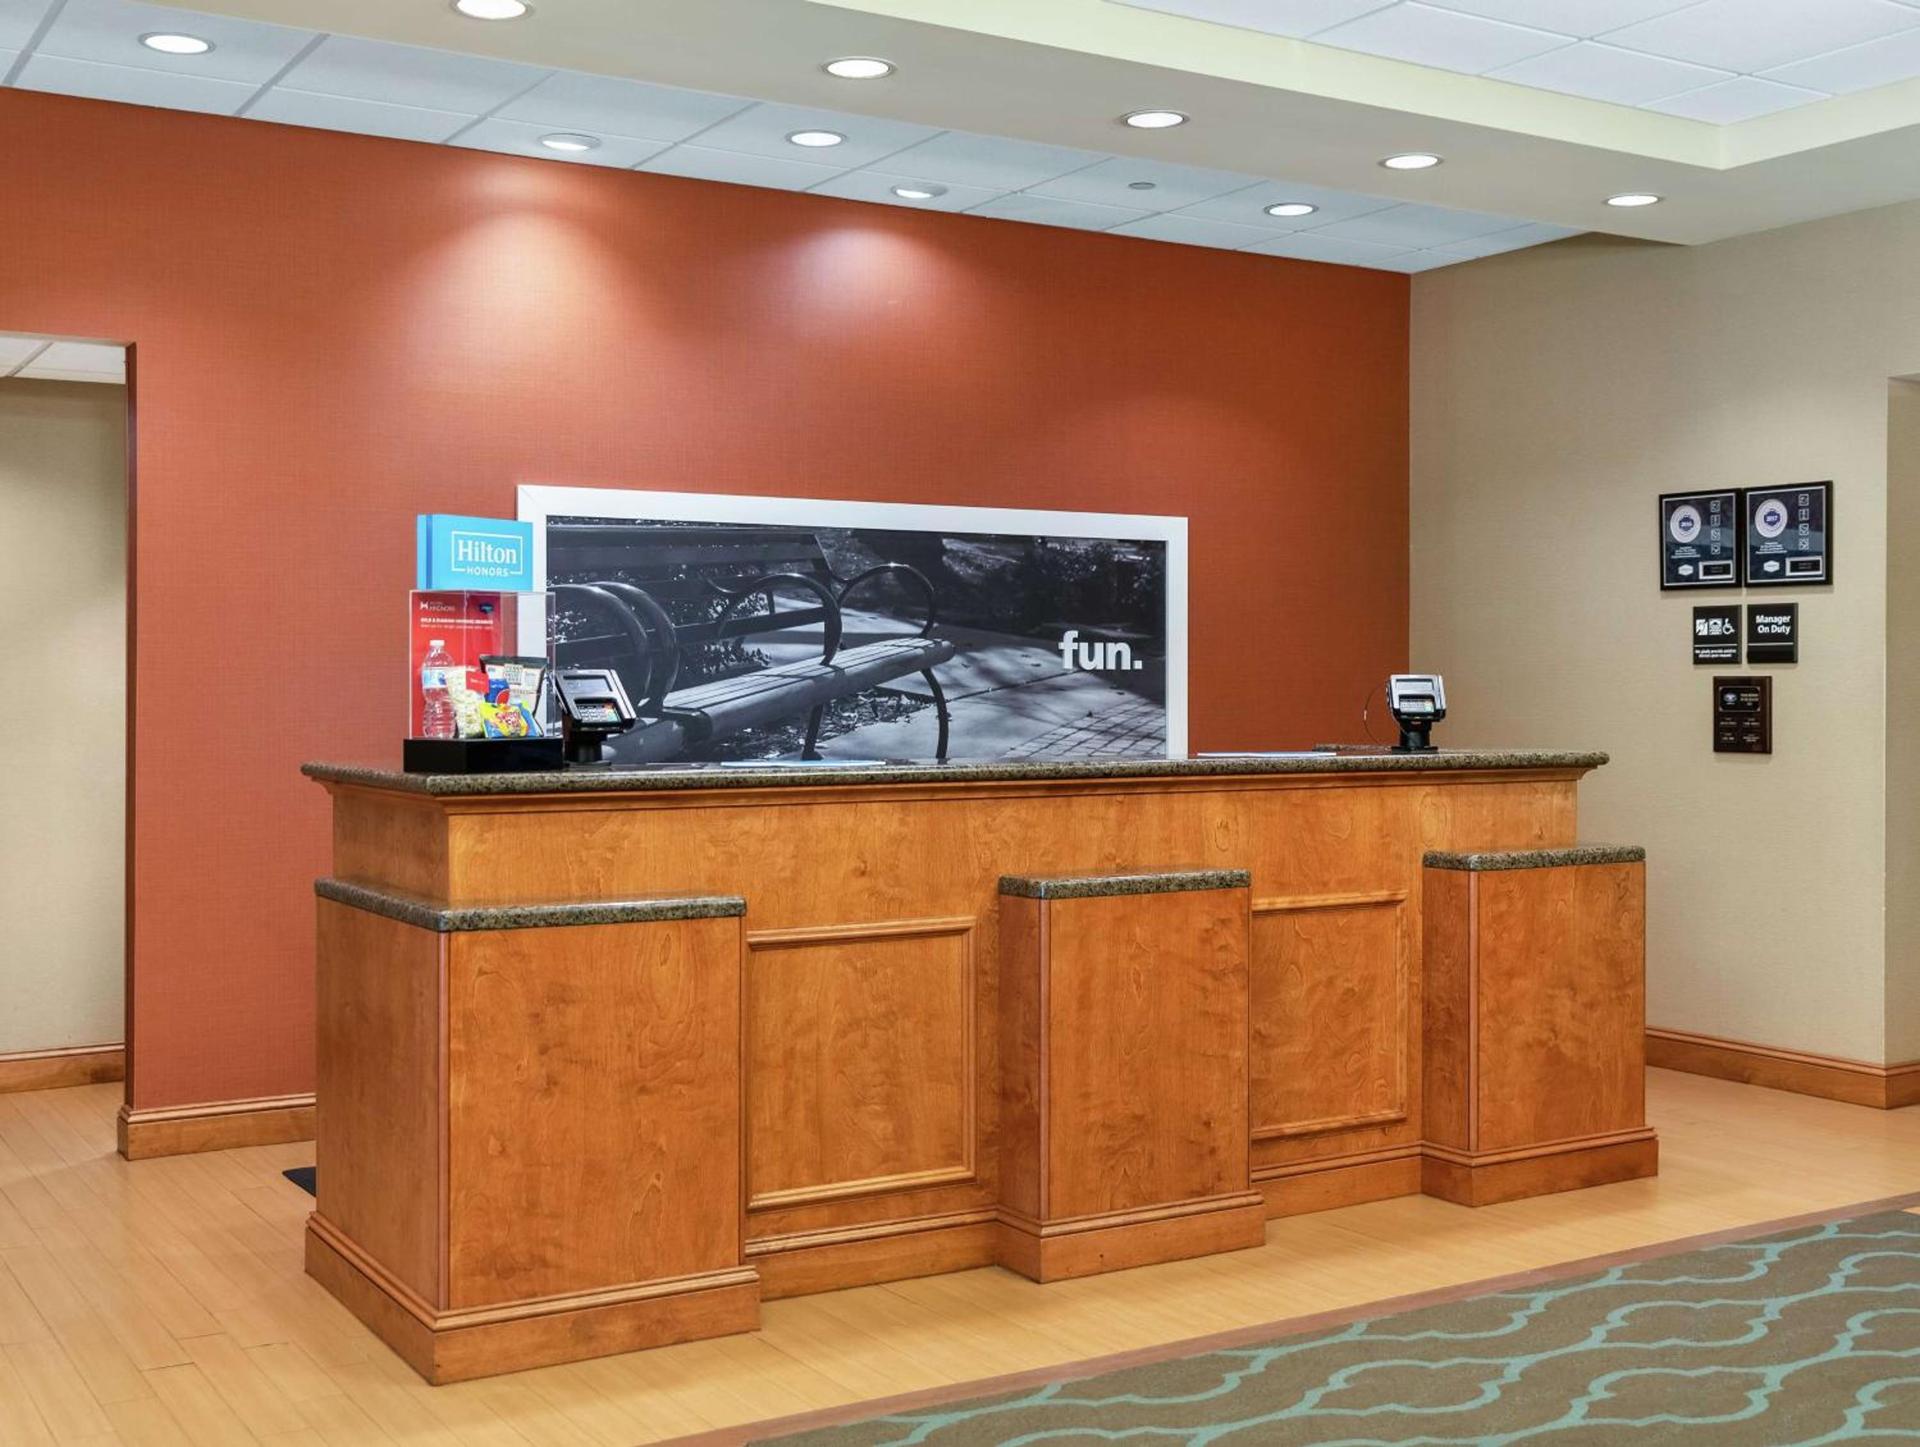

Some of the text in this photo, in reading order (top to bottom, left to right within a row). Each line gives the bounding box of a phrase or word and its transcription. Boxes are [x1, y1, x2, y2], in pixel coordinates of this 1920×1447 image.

[458, 539, 517, 564] Hilton
[466, 566, 509, 577] HONORS
[1755, 615, 1791, 626] Manager
[1757, 624, 1791, 635] On Duty
[1058, 630, 1143, 671] fun.
